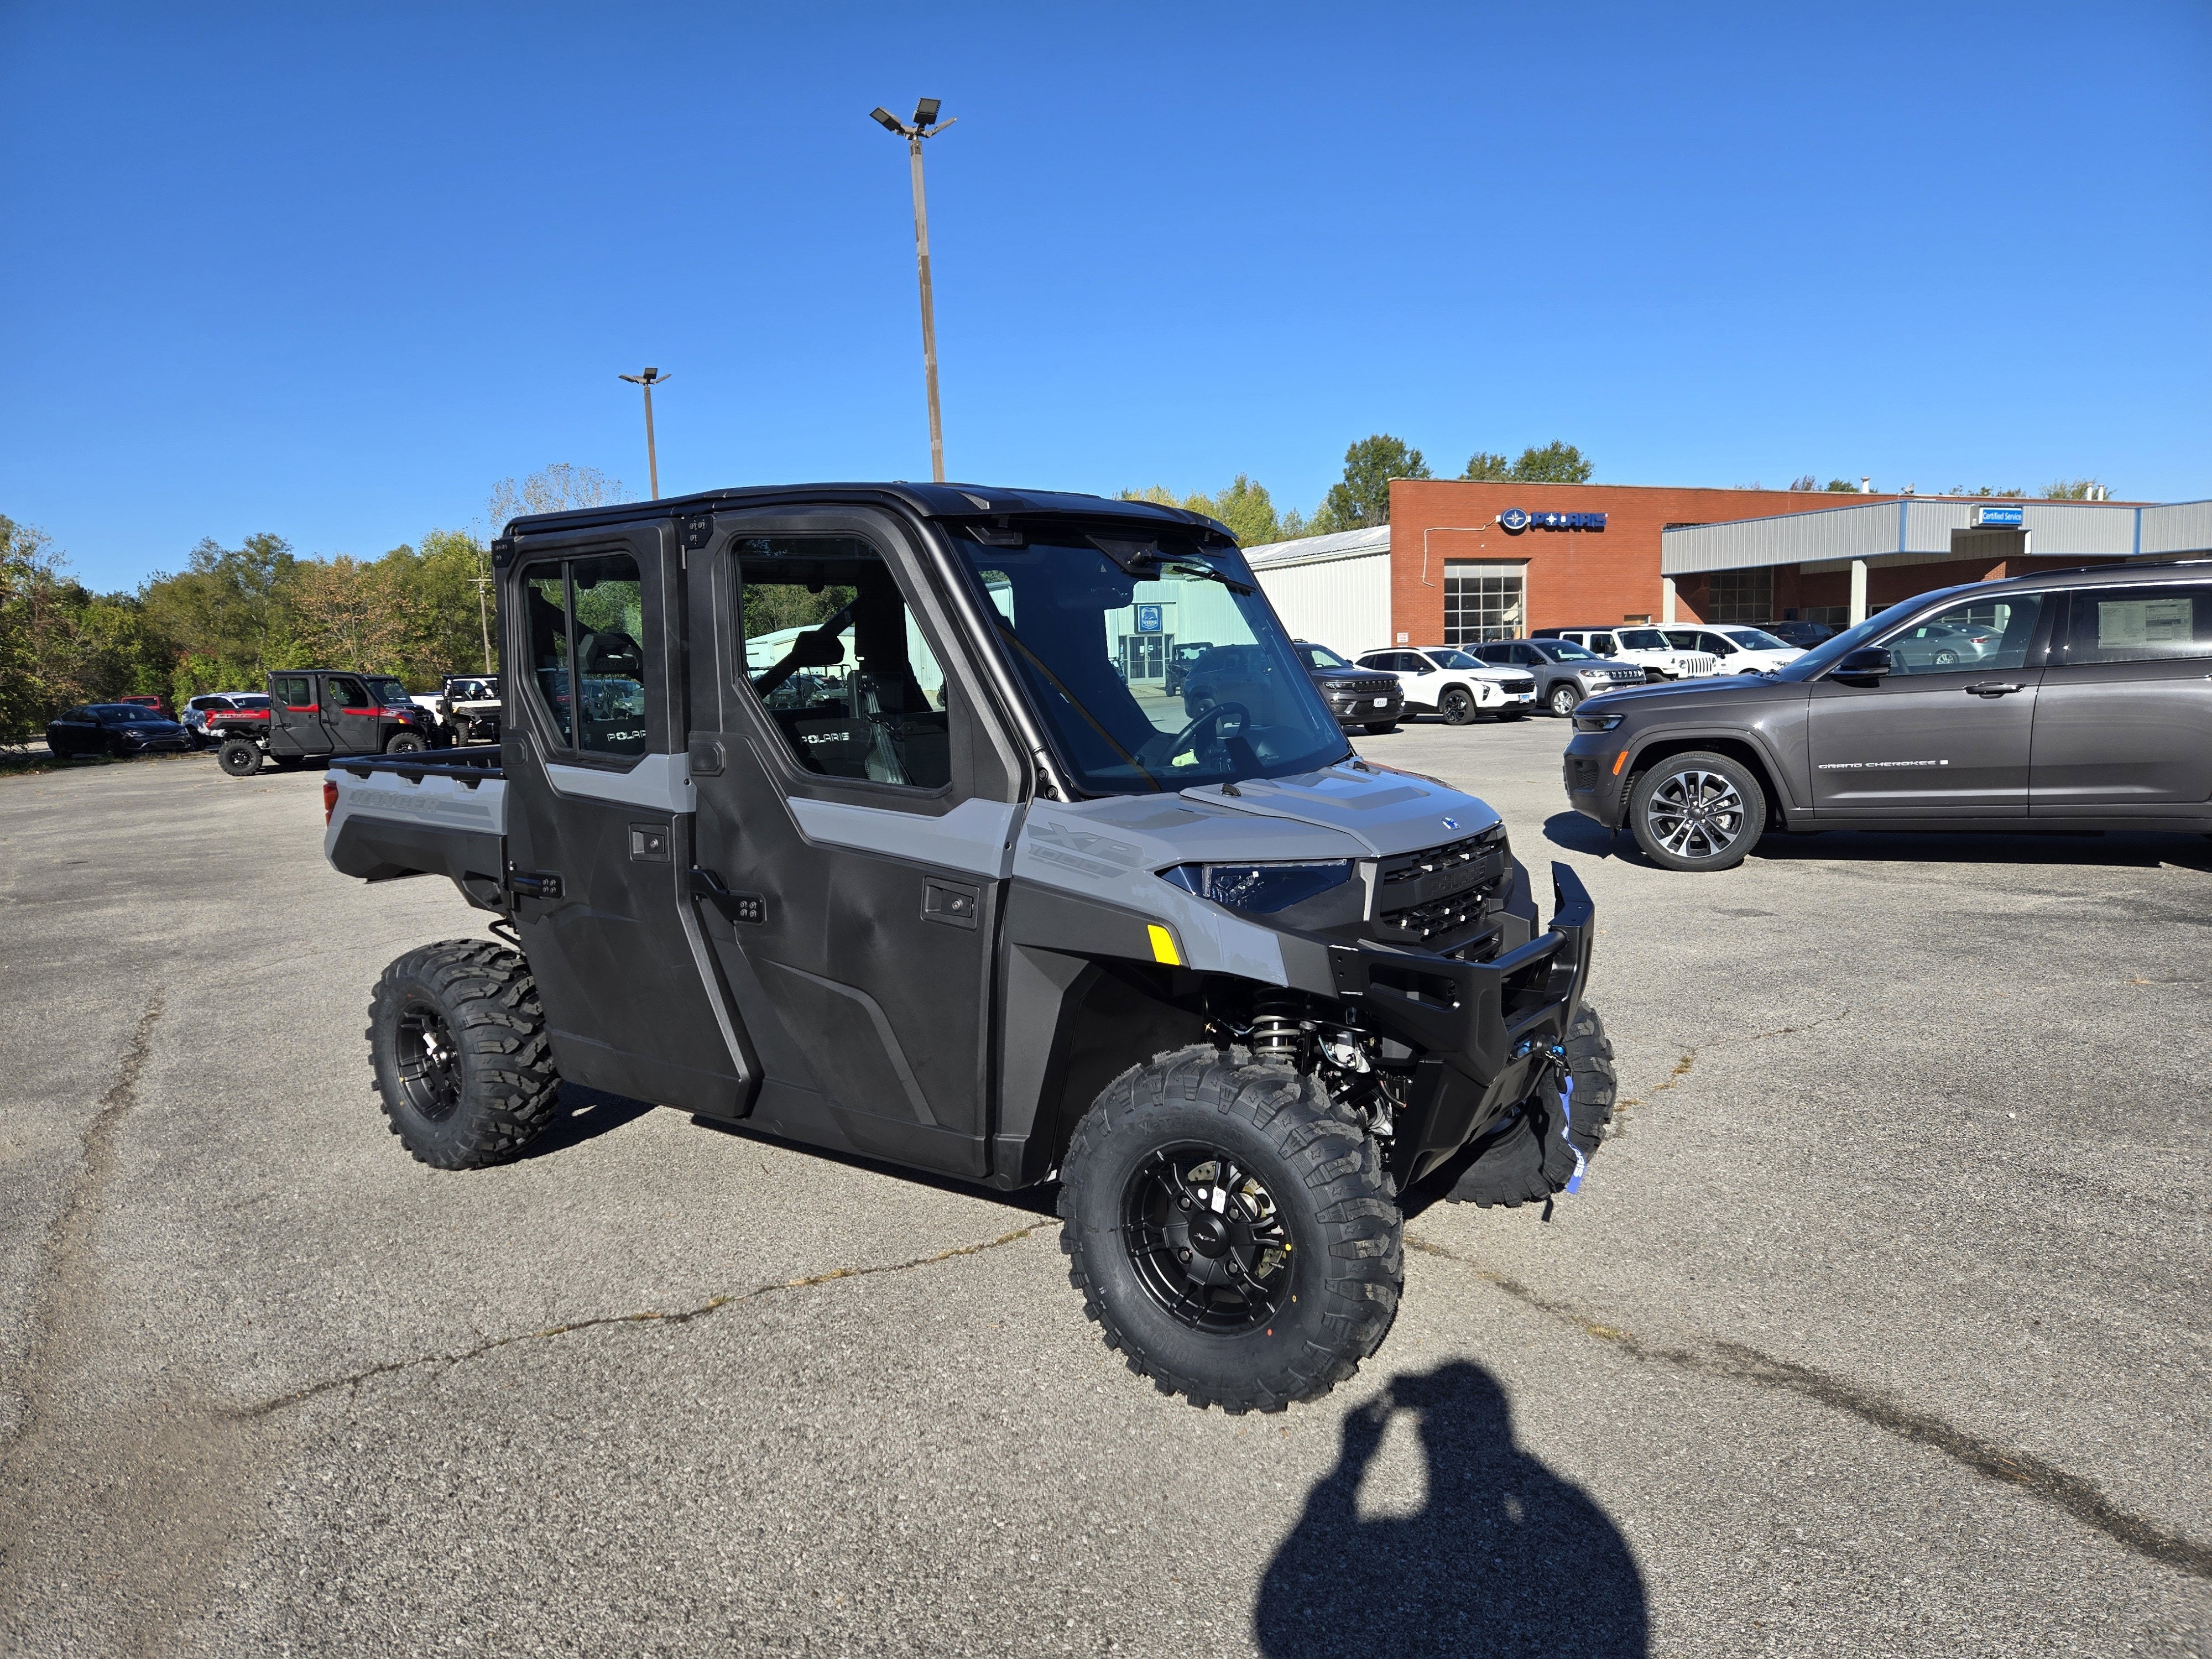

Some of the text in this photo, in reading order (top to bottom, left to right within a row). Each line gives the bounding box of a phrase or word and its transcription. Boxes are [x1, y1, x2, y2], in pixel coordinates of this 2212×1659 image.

[1531, 512, 1607, 526] POLARIS
[1983, 512, 2022, 520] Certified Service
[352, 789, 440, 813] RANGER
[1027, 821, 1149, 863] XP
[1429, 861, 1486, 897] POLARIS
